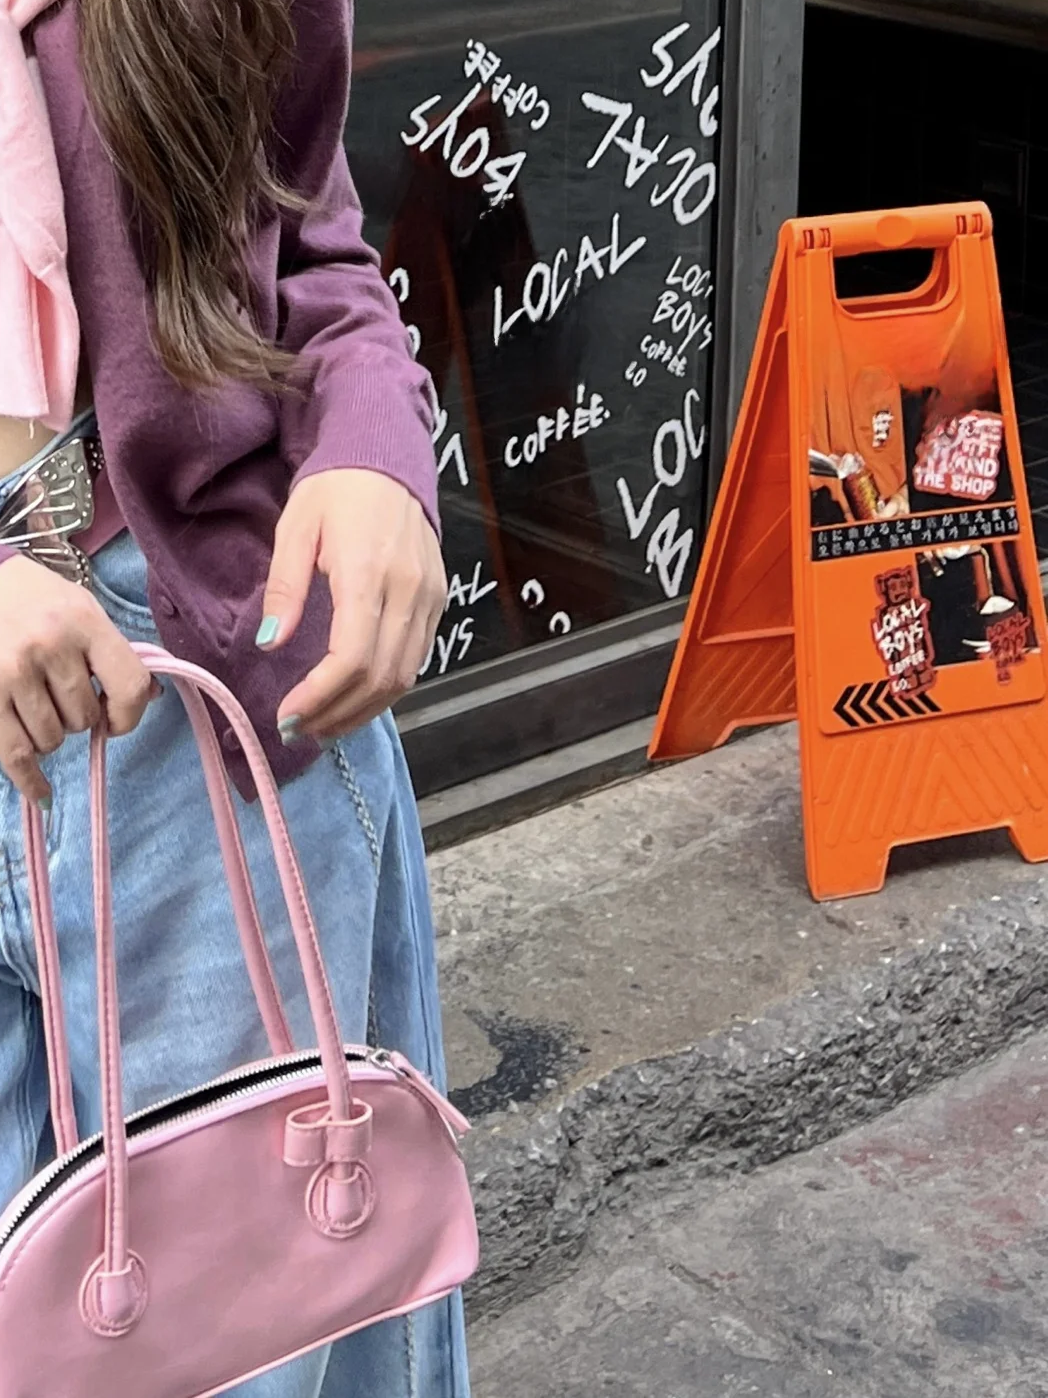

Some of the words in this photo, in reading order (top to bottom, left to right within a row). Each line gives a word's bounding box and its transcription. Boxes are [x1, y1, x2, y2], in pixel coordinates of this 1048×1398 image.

[491, 211, 647, 347] LOCAL
[652, 289, 713, 359] BOYS
[950, 473, 995, 496] SHOP
[872, 598, 927, 642] LOCAL
[878, 620, 924, 661] BOYS
